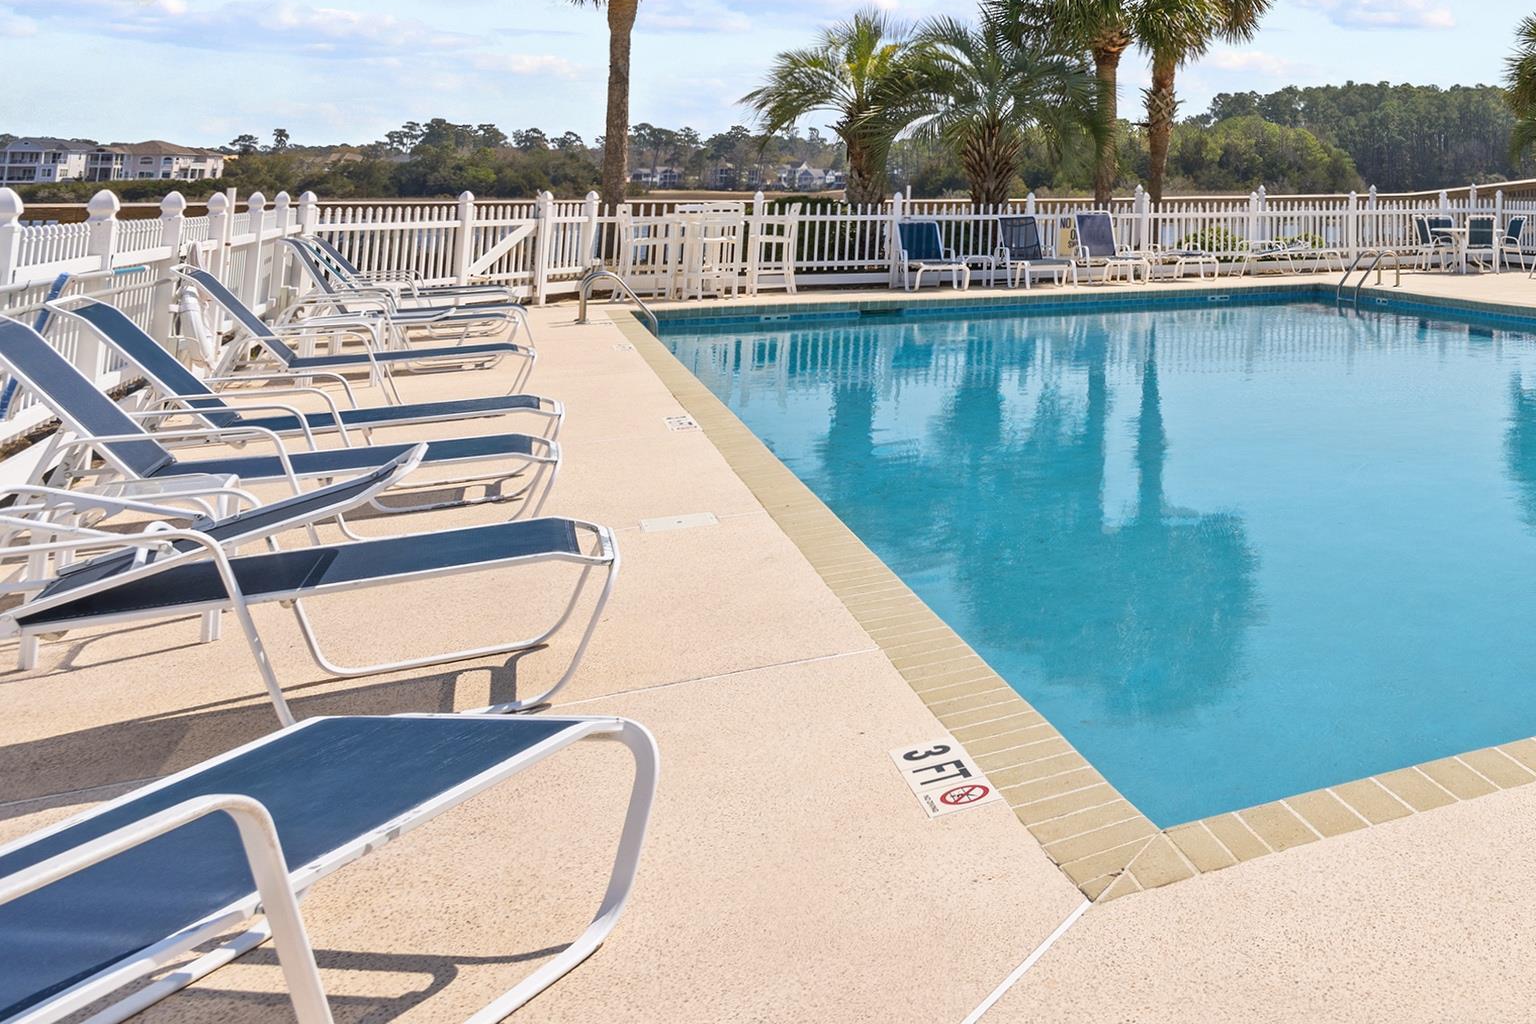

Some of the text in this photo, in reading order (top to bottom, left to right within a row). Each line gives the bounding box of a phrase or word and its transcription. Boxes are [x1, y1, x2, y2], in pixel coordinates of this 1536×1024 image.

[1060, 217, 1071, 229] NO
[903, 744, 972, 786] 3 FT
